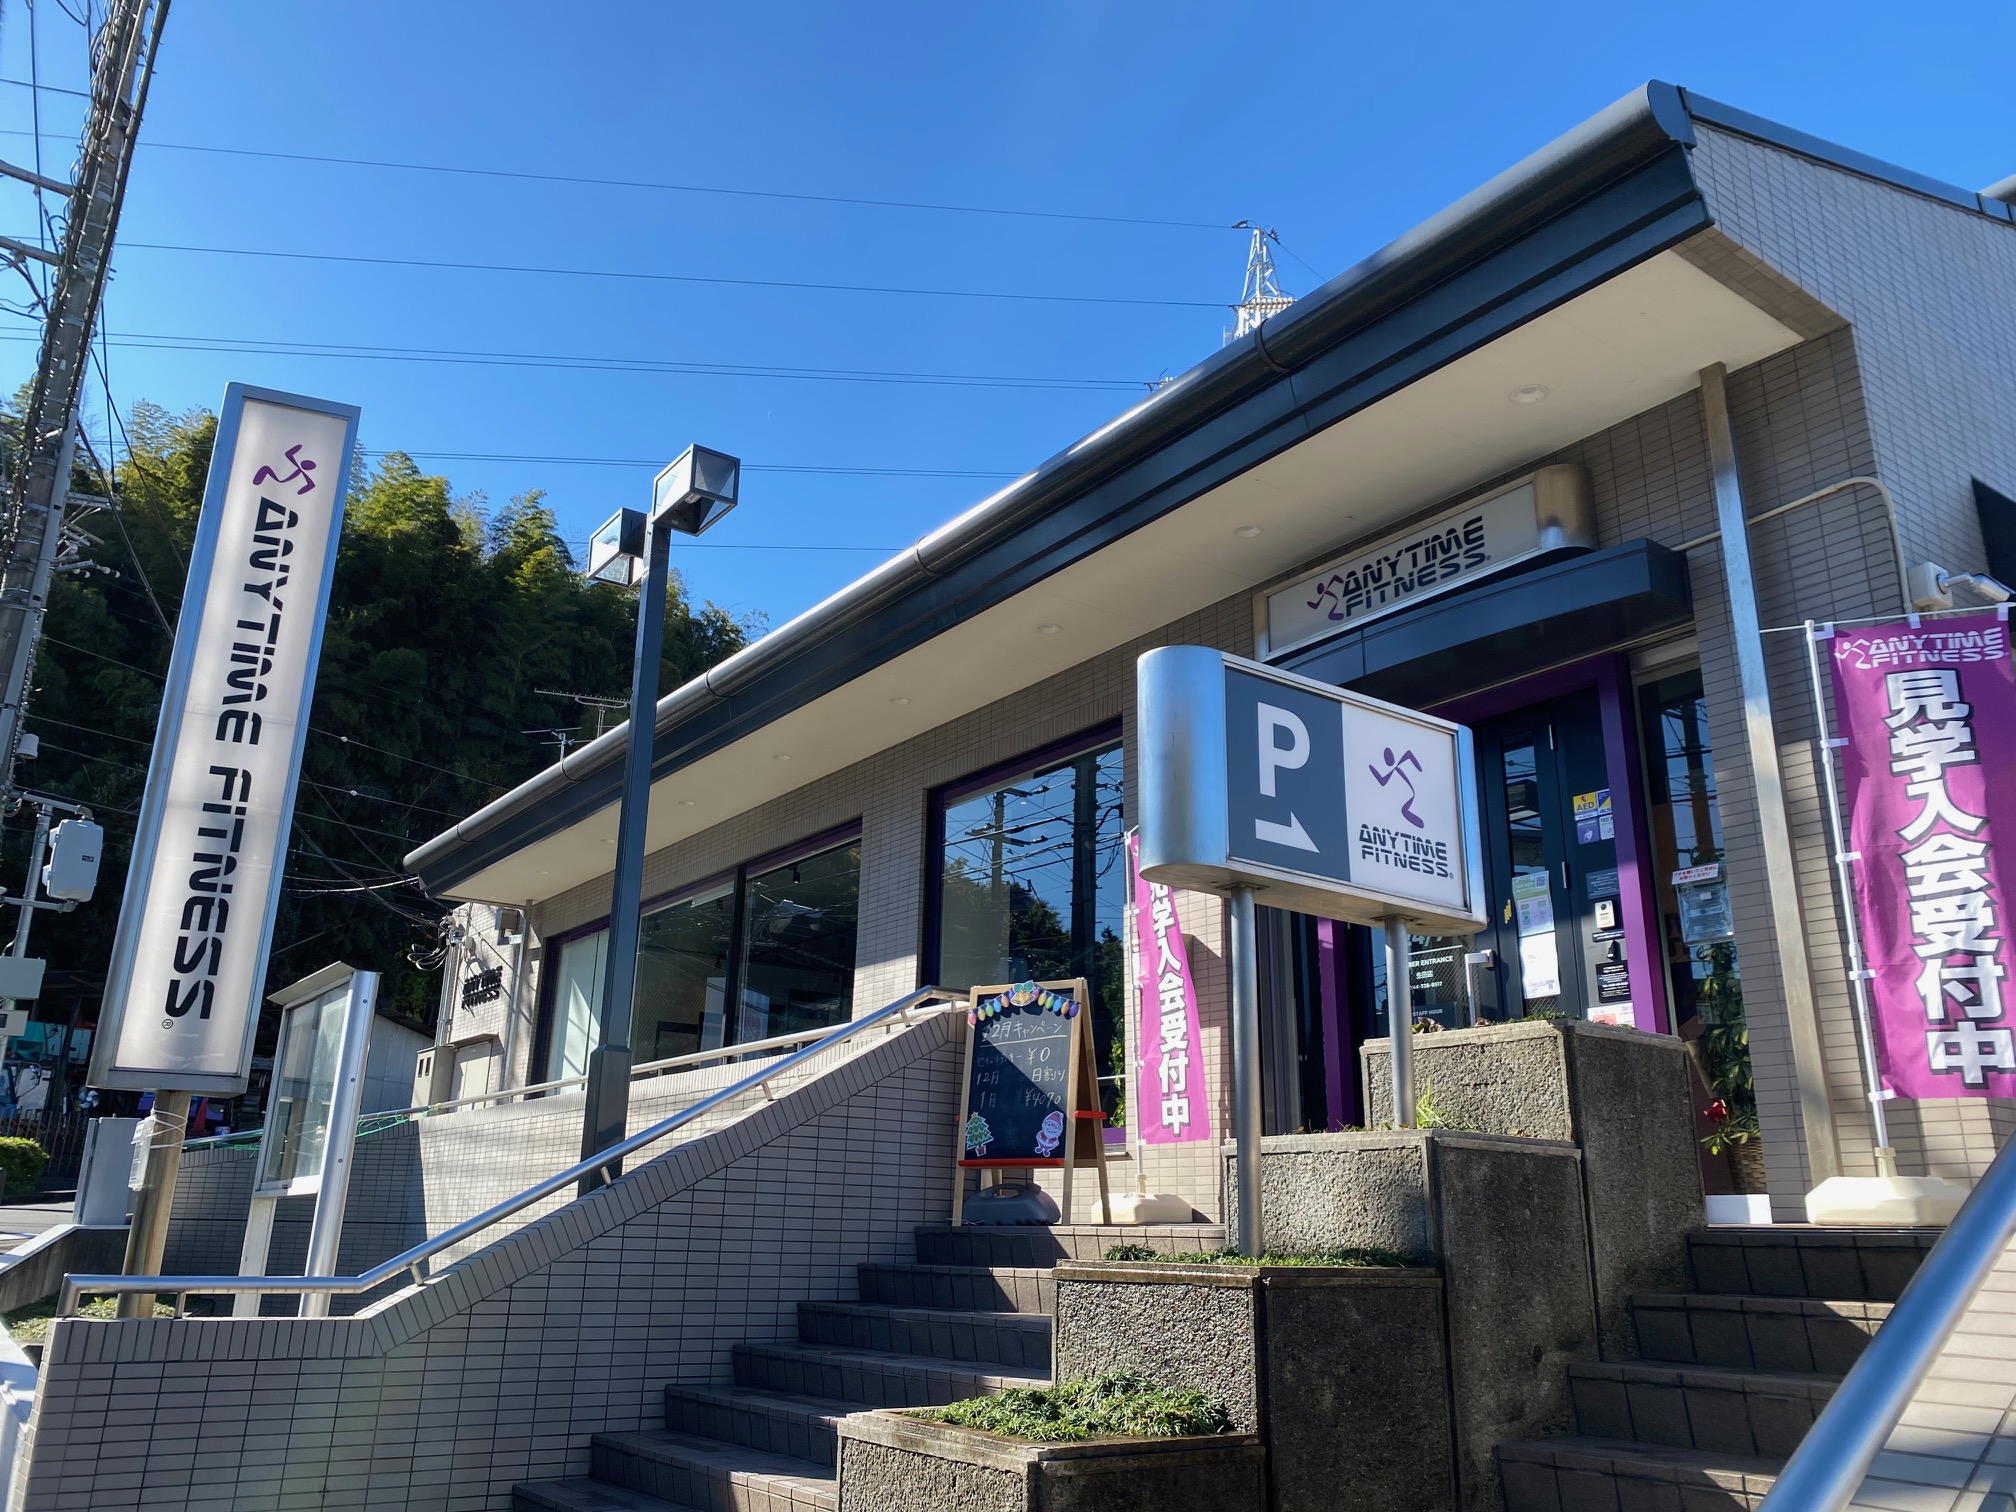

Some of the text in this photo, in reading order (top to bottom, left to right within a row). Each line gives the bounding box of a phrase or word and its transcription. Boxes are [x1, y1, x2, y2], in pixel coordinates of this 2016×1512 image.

[1342, 515, 1485, 598] ANYTIME
[1345, 542, 1486, 618] FITNESS
[1868, 626, 2004, 655] ANYTIME
[1871, 644, 2005, 668] FITNESS
[164, 496, 299, 1020] ANYTIME FITNESS
[1257, 701, 1311, 798] P
[1577, 801, 1595, 812] AED
[1358, 823, 1448, 862] ANYTIME
[1361, 844, 1449, 878] FITNESS
[1884, 668, 2016, 1086] 見学入会受付中
[1420, 955, 1454, 966] ENTRANCE
[976, 1065, 1066, 1086] 12月 日割り
